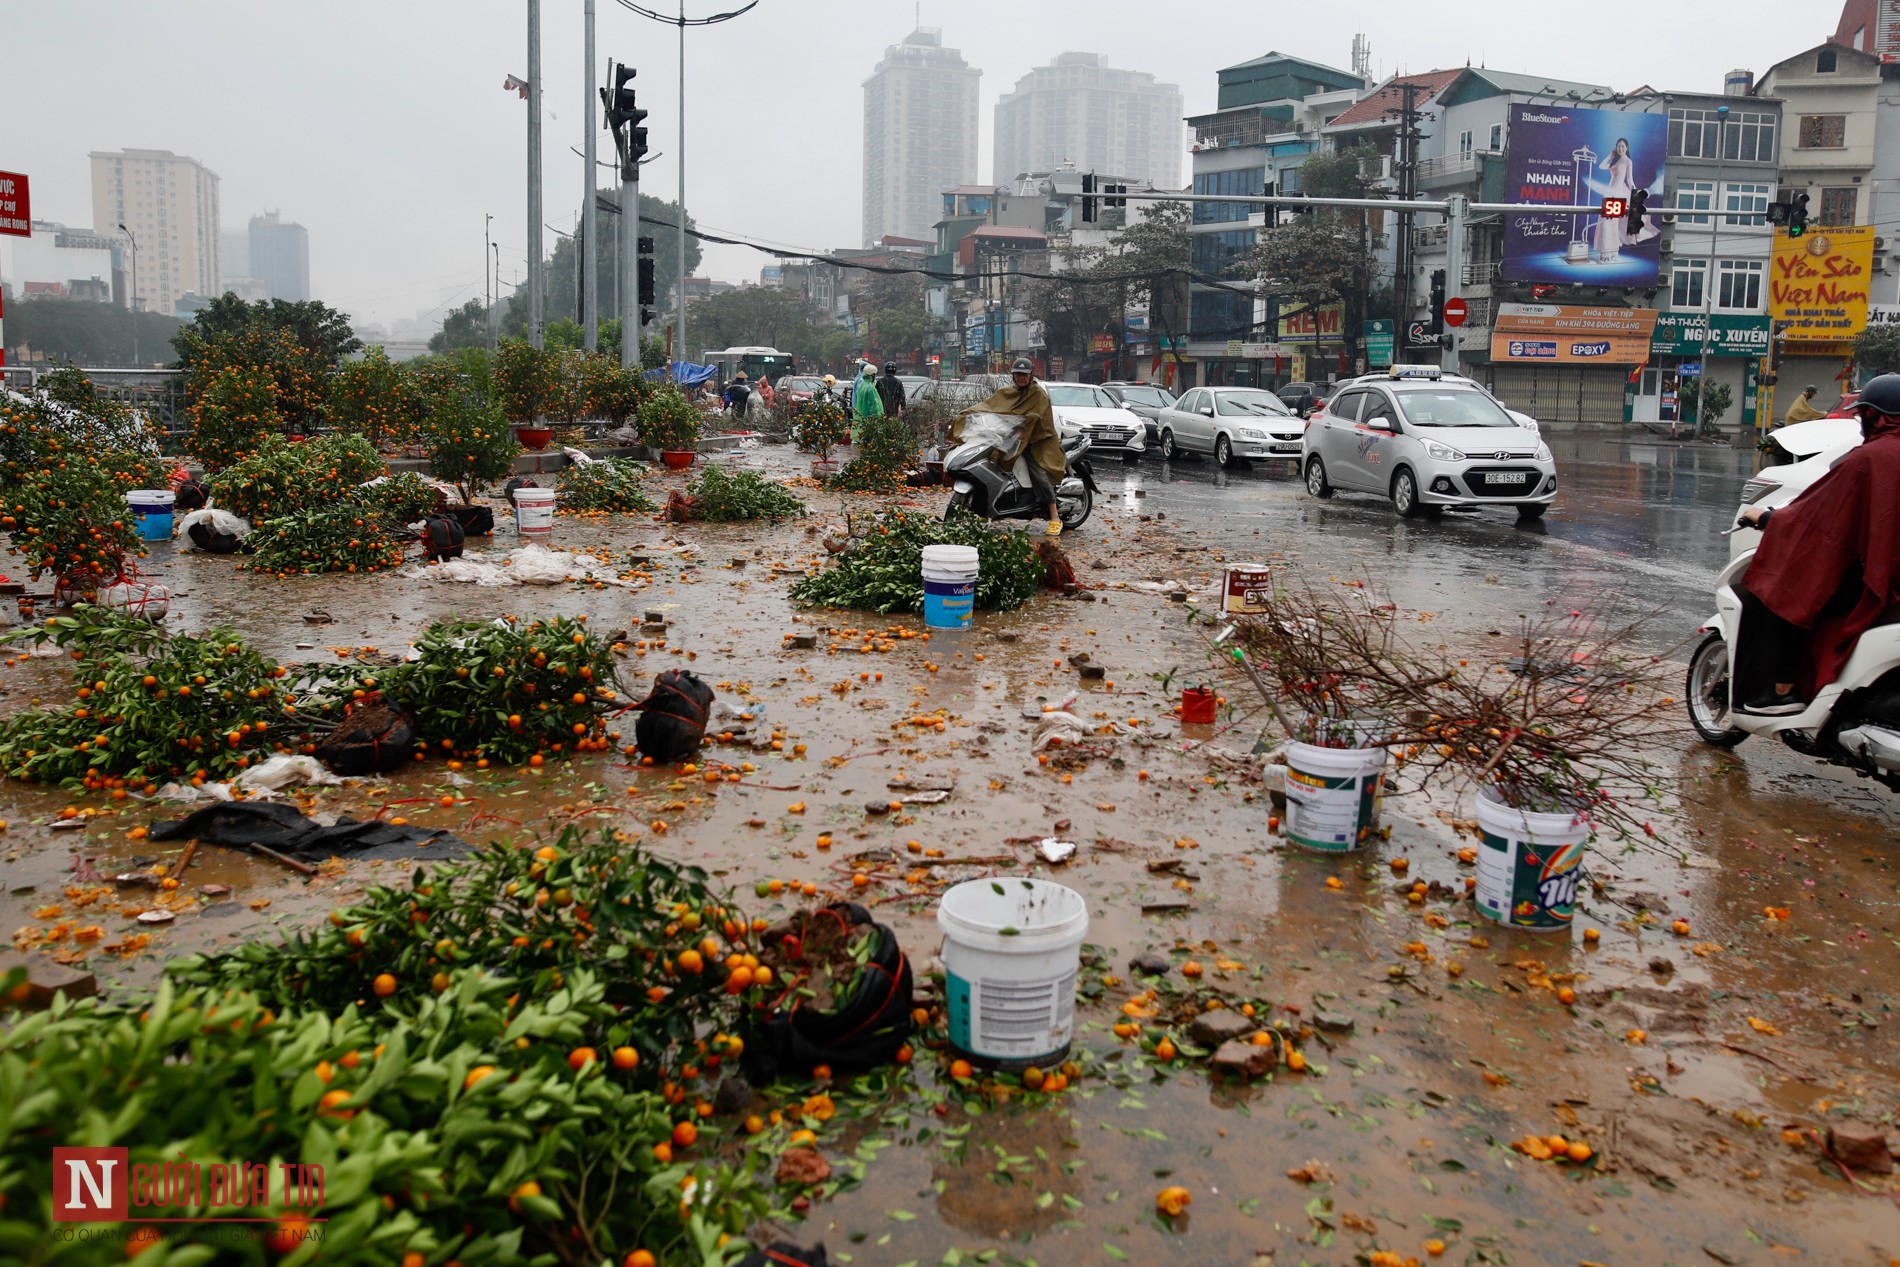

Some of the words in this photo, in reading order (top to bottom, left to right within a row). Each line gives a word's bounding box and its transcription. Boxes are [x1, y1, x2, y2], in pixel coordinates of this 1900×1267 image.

[1522, 112, 1562, 124] BlueStone
[1526, 172, 1571, 186] NHANH
[4, 201, 16, 215] CHỢ
[1605, 201, 1622, 215] 58
[12, 219, 28, 231] RONG
[1551, 225, 1567, 236] tha
[1777, 254, 1820, 279] Yến
[1822, 255, 1862, 279] Sào
[1772, 280, 1813, 307] Việt
[1815, 281, 1867, 305] Nam
[1785, 308, 1801, 317] NHÀ
[1824, 306, 1846, 316] THÁC
[1555, 319, 1569, 327] KIM
[1570, 318, 1582, 328] KHÍ
[1582, 320, 1596, 328] 394
[1657, 315, 1676, 326] NHÀ
[1796, 317, 1814, 328] TIẾP
[1725, 325, 1768, 343] XUYẾN
[1572, 344, 1605, 356] EPOXY
[1486, 474, 1525, 483] 30E-152.82
